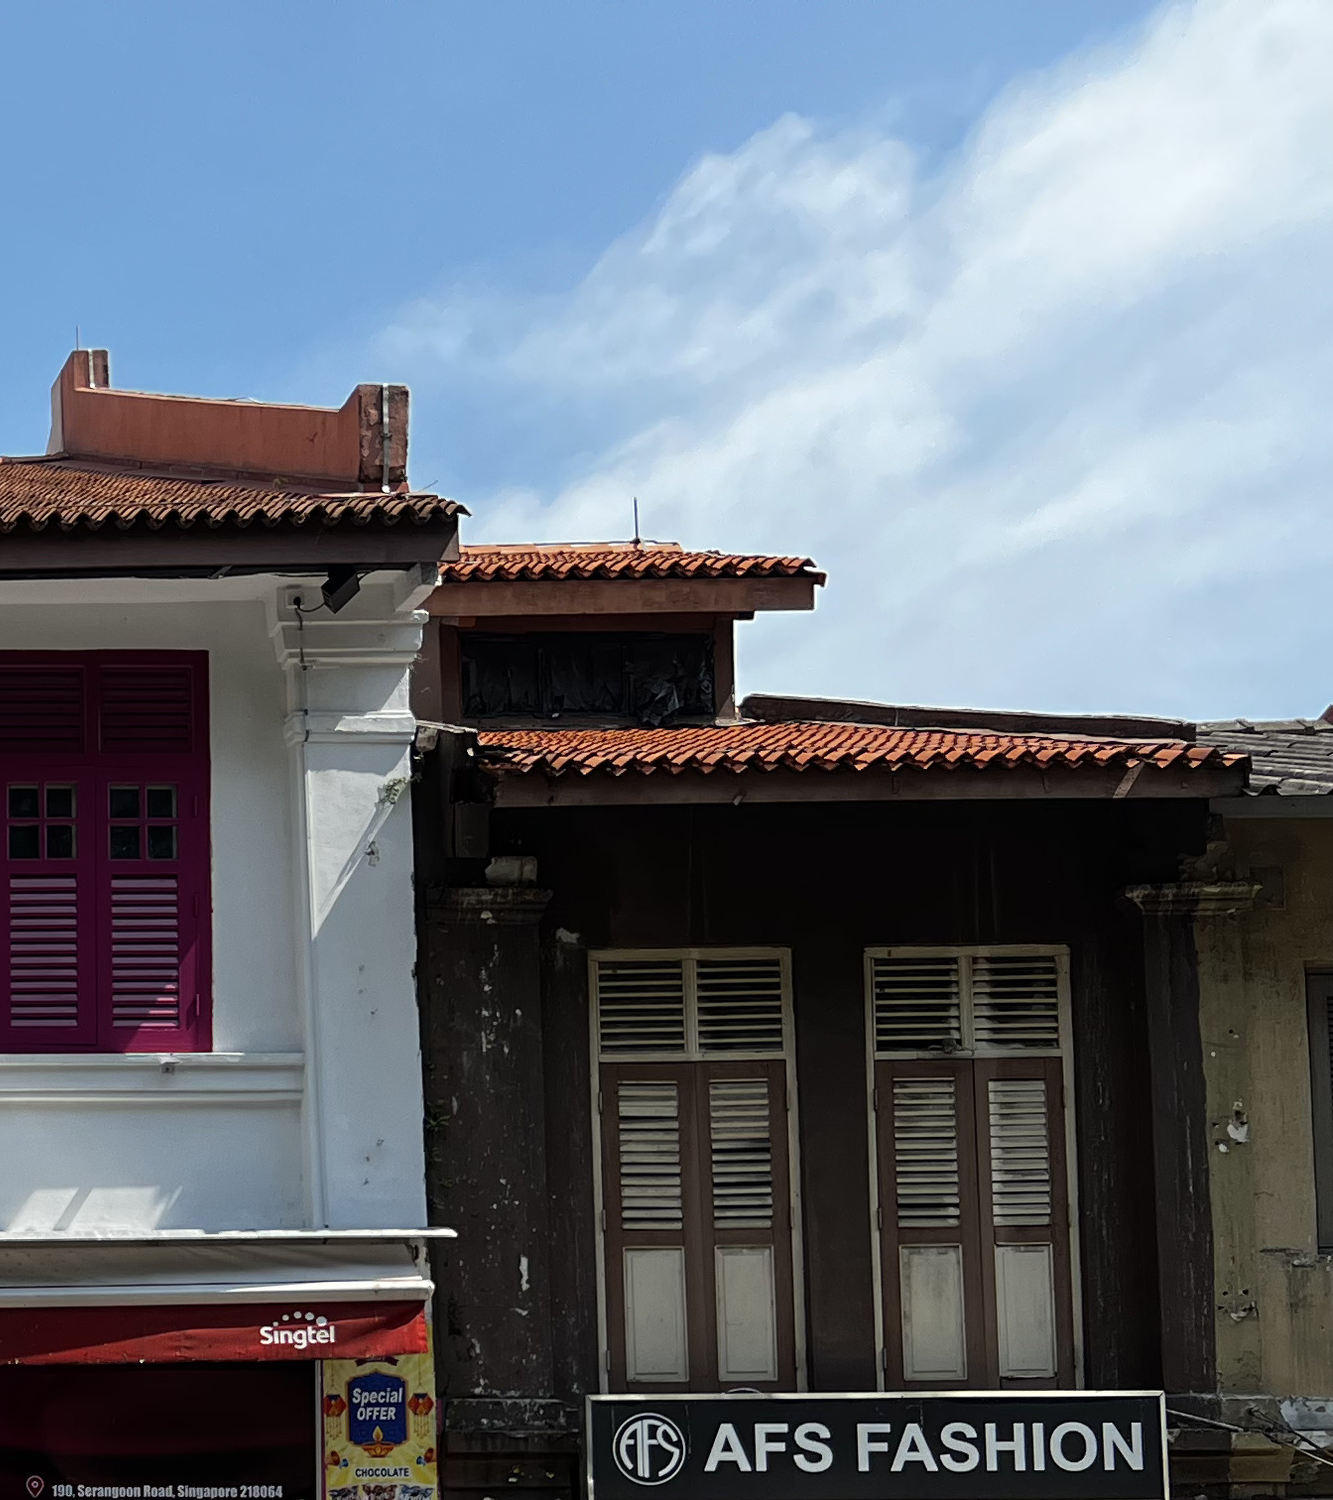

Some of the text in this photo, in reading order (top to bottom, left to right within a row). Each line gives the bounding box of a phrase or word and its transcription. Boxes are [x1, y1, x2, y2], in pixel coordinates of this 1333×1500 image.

[260, 1321, 336, 1349] Singtel
[352, 1388, 403, 1404] Special
[357, 1407, 396, 1421] OFFER
[704, 1422, 833, 1473] AFS
[856, 1421, 1144, 1473] FASHION
[355, 1467, 409, 1477] CHOCOLATE
[51, 1485, 75, 1500] 190,
[77, 1484, 142, 1499] Serangoon
[143, 1484, 176, 1500] Road,
[239, 1485, 283, 1500] 218064
